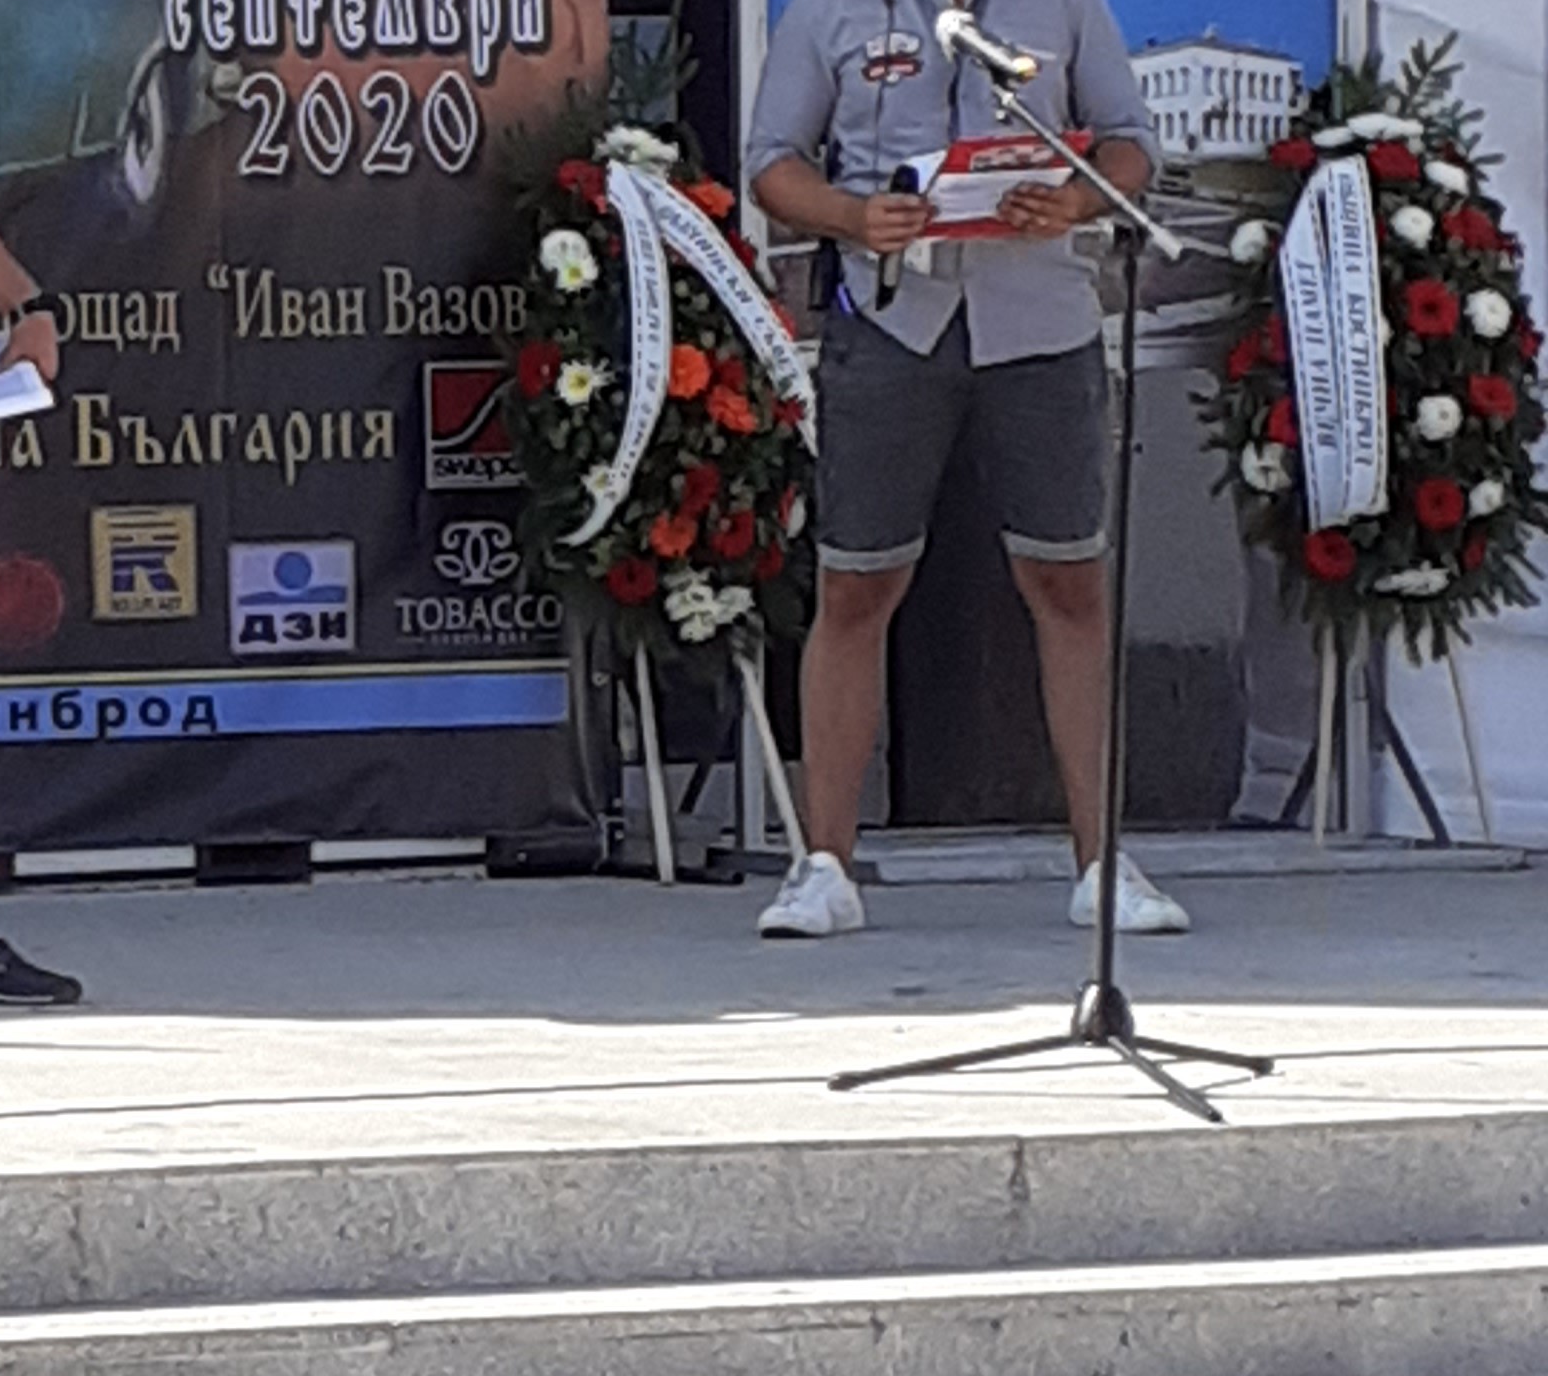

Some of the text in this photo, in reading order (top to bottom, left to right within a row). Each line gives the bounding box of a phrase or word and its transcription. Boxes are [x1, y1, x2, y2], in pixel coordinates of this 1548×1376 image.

[237, 69, 480, 176] 2020
[71, 392, 397, 486] България
[238, 610, 349, 646] ДЗИ
[394, 592, 564, 633] TOBACCO
